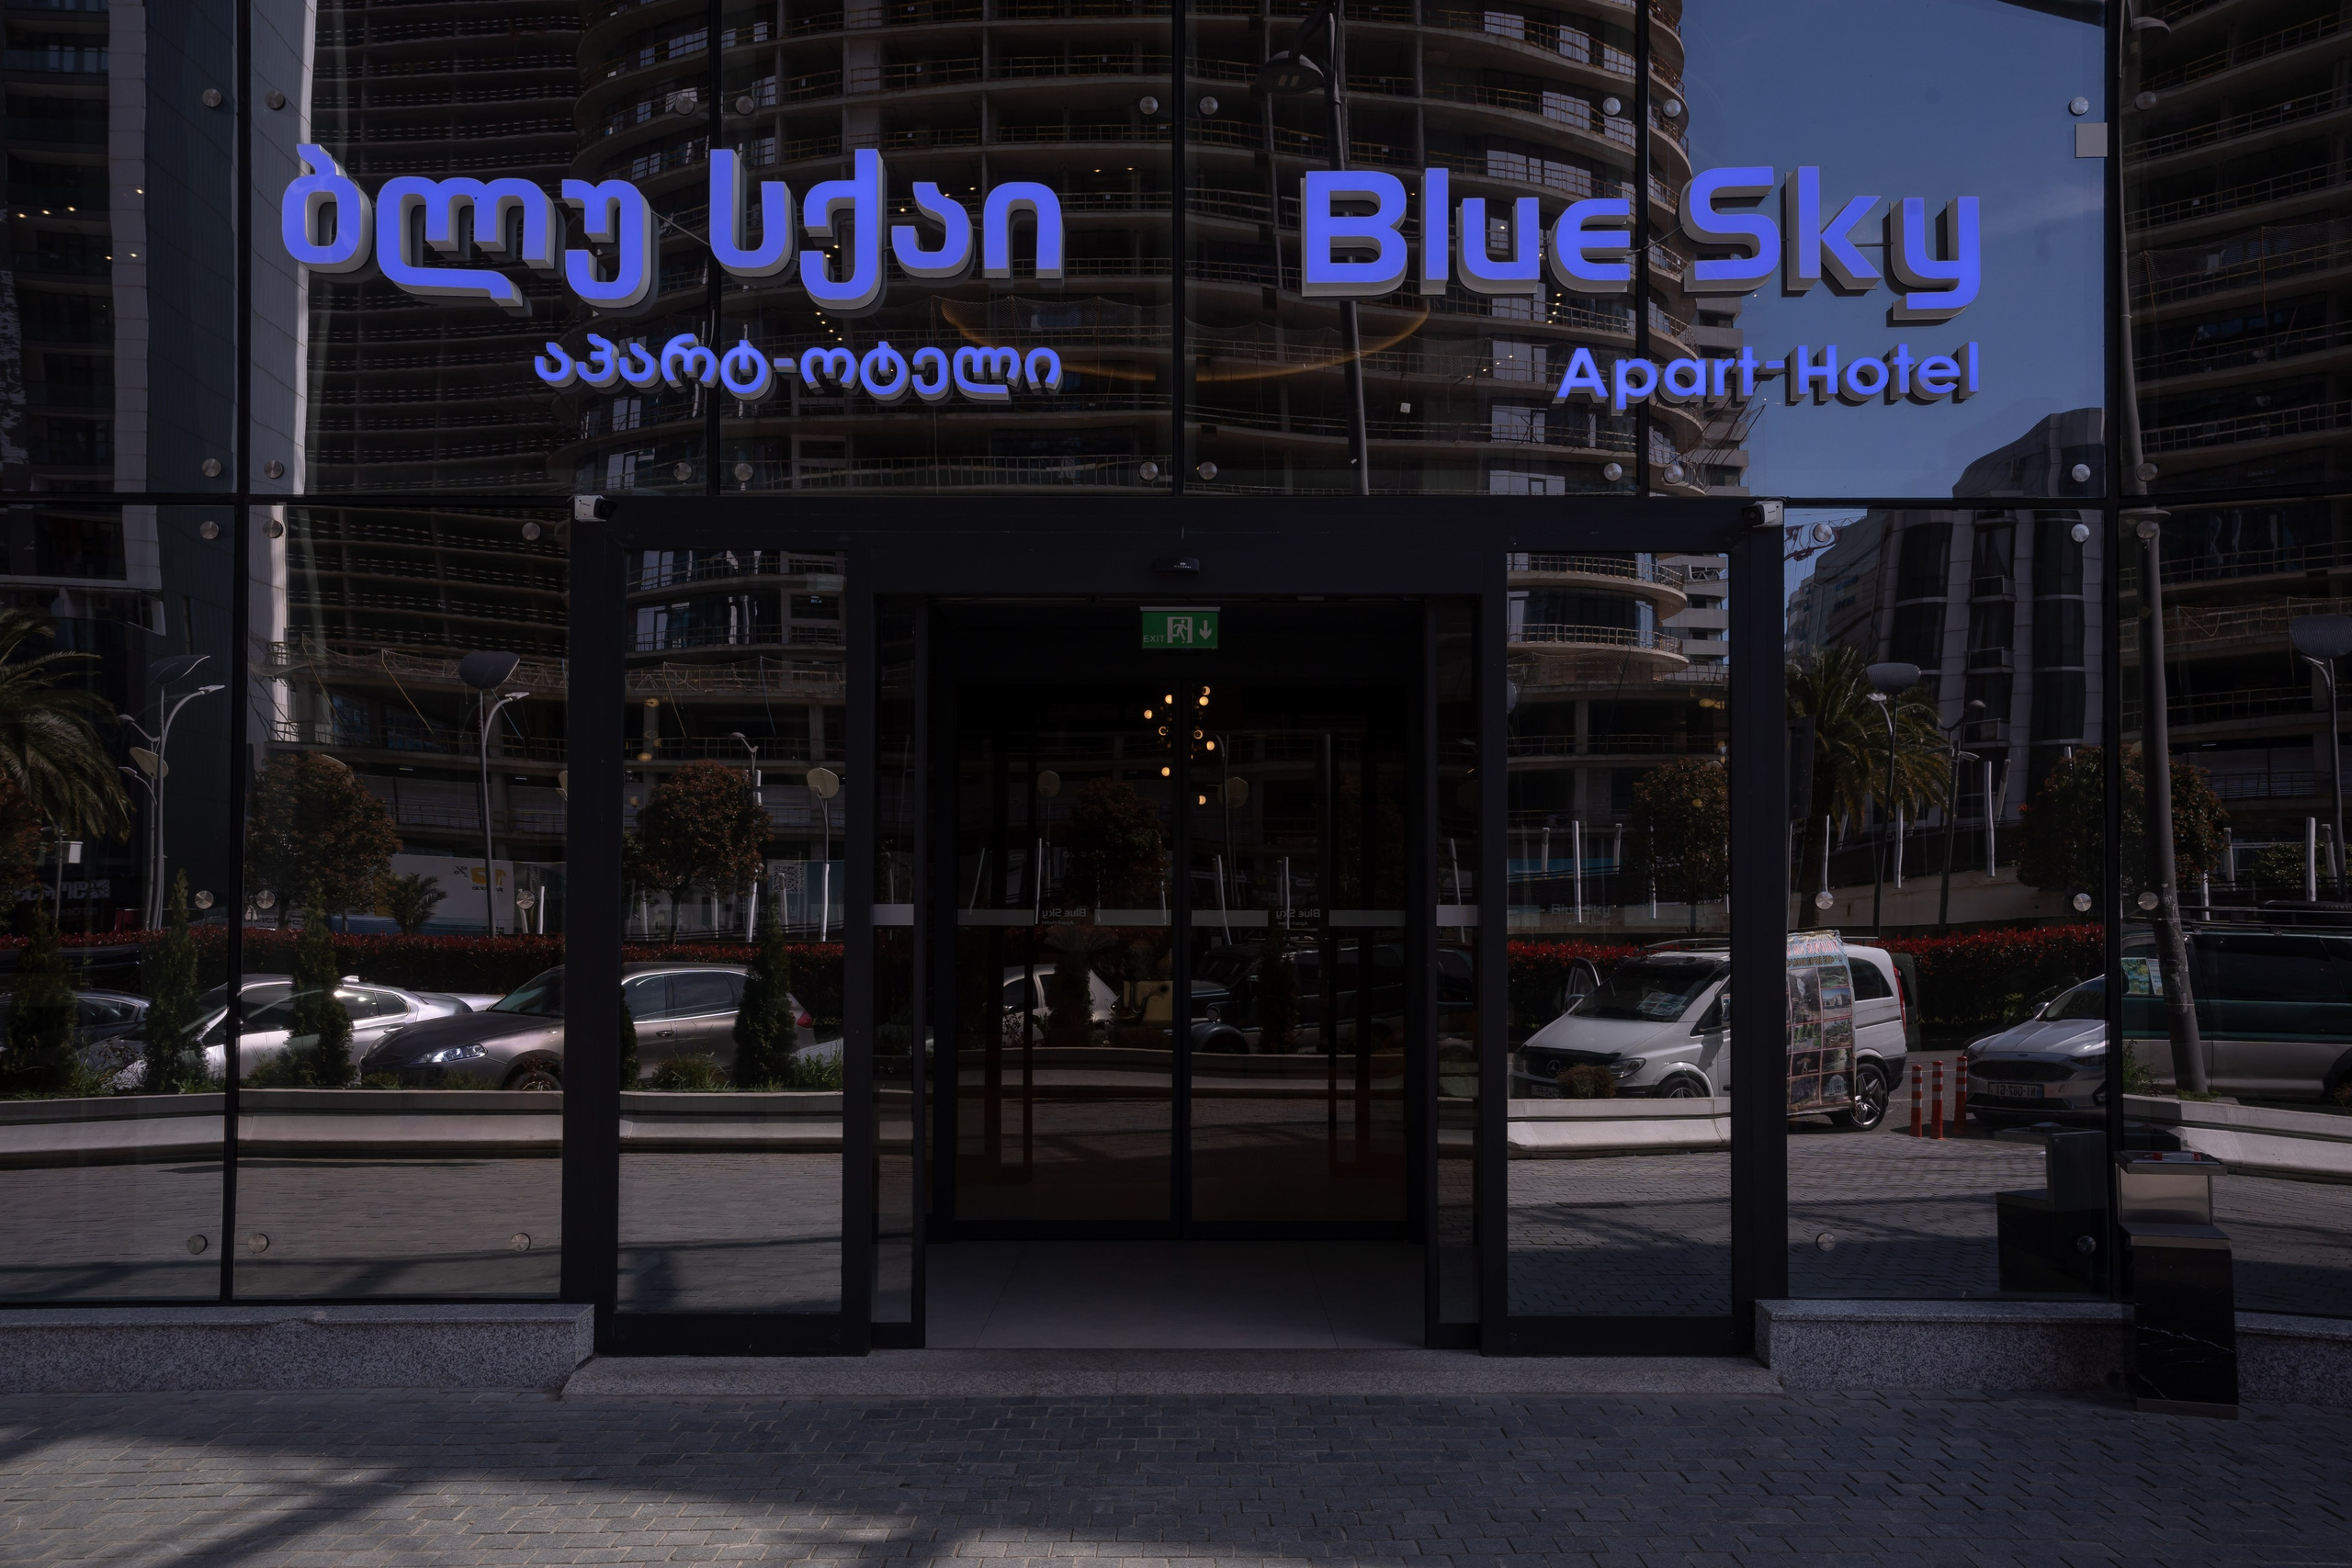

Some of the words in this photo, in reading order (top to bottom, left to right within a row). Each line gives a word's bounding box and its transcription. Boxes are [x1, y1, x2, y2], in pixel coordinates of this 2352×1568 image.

[281, 143, 645, 300] ბლუ
[709, 148, 1062, 301] სქაი
[1305, 168, 1631, 285] Blue
[1688, 165, 1983, 311] Sky
[534, 333, 1062, 396] აპარტ-ოტელი
[1556, 340, 1981, 411] Apart-Hotel
[1142, 634, 1166, 643] EXIT
